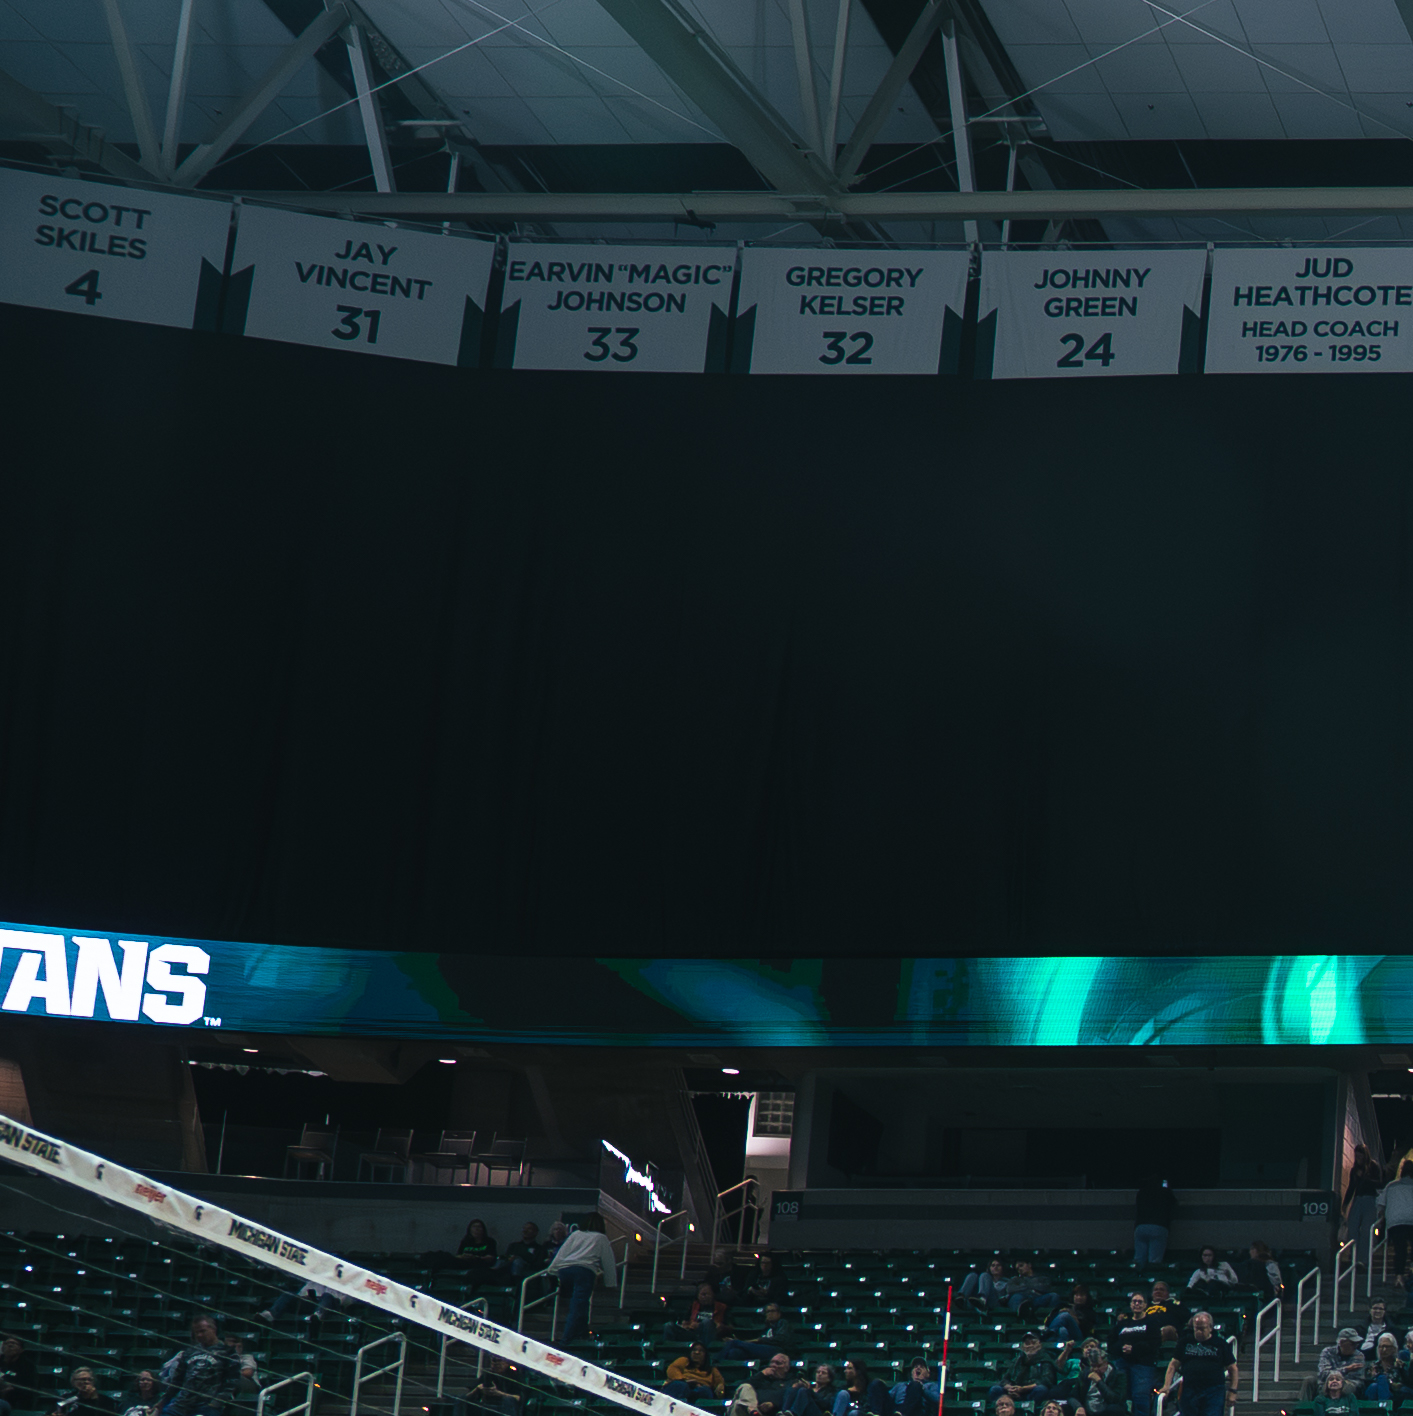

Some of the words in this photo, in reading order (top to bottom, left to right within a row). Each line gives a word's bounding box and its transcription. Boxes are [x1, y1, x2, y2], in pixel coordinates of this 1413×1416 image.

[38, 194, 151, 232] SCOTT
[34, 223, 147, 261] SKILES
[335, 238, 398, 267] JAY
[295, 261, 433, 302] VINCENT
[509, 261, 612, 284] EARVIN
[785, 266, 923, 289] GREGORY
[1033, 267, 1151, 290] JOHNNY
[1295, 257, 1354, 279] JUD
[64, 269, 103, 307] 4
[1232, 284, 1413, 308] HEATHCOTE
[547, 289, 687, 315] JOHNSON
[799, 295, 906, 317] KELSER
[1043, 295, 1138, 318] GREEN
[331, 304, 382, 345] 31
[1241, 320, 1309, 339] HEAD
[1313, 319, 1400, 338] COACH
[583, 326, 641, 364] 33
[818, 330, 874, 366] 32
[1056, 331, 1116, 369] 24
[1254, 344, 1309, 363] 1976
[1328, 344, 1382, 363] 1995
[0, 929, 210, 1025] ANS
[23, 1133, 62, 1165] STATE
[776, 1202, 799, 1214] 108
[1303, 1202, 1329, 1215] 109
[228, 1218, 280, 1254] MICHIGAN
